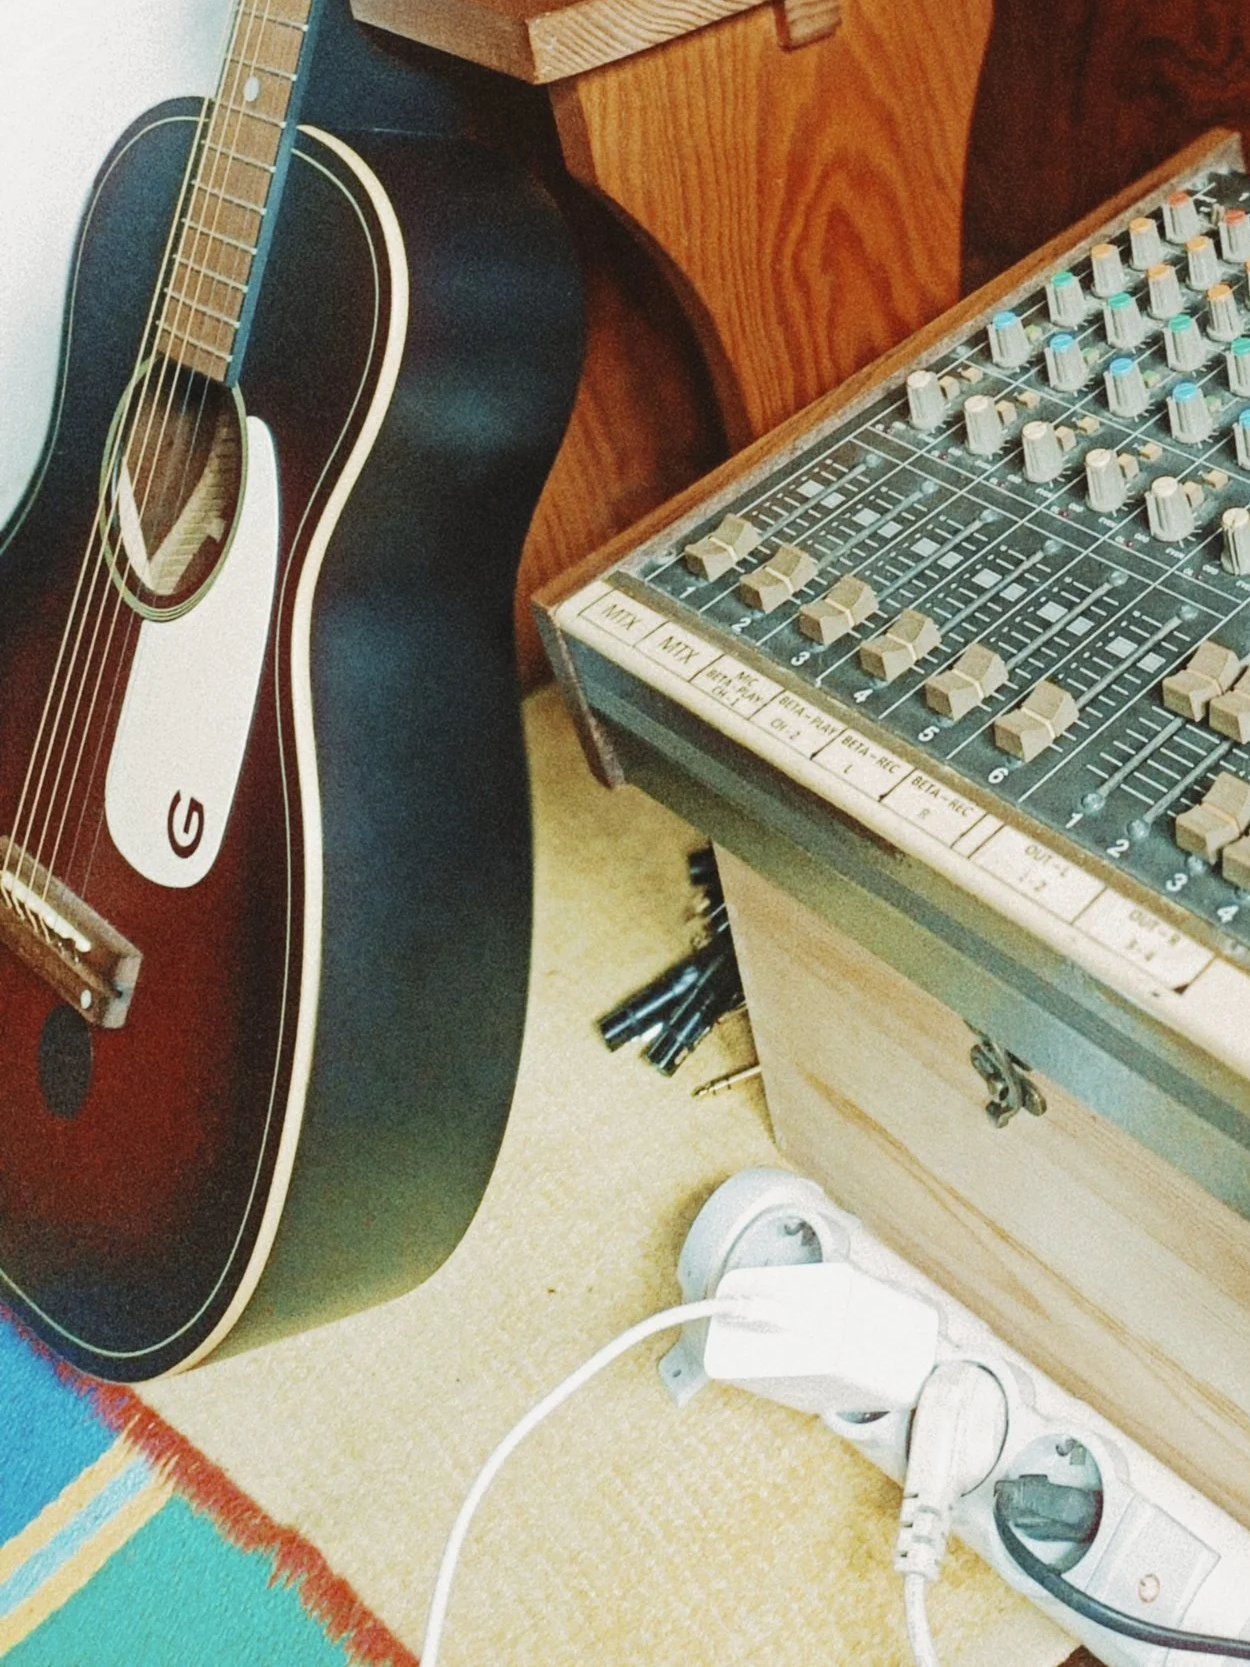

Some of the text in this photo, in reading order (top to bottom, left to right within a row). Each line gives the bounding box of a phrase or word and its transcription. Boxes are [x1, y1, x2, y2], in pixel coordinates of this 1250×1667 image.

[680, 586, 696, 599] 1
[601, 604, 641, 631] MTX
[731, 616, 752, 633] 2
[659, 635, 700, 665] MTX
[791, 651, 810, 666] 3
[853, 687, 874, 704] 4
[918, 726, 940, 742] 5
[988, 767, 1010, 784] 6
[166, 788, 205, 860] G
[1064, 812, 1084, 829] 1
[1106, 838, 1130, 858] 2
[1166, 872, 1188, 892] 3
[1216, 904, 1240, 923] 4
